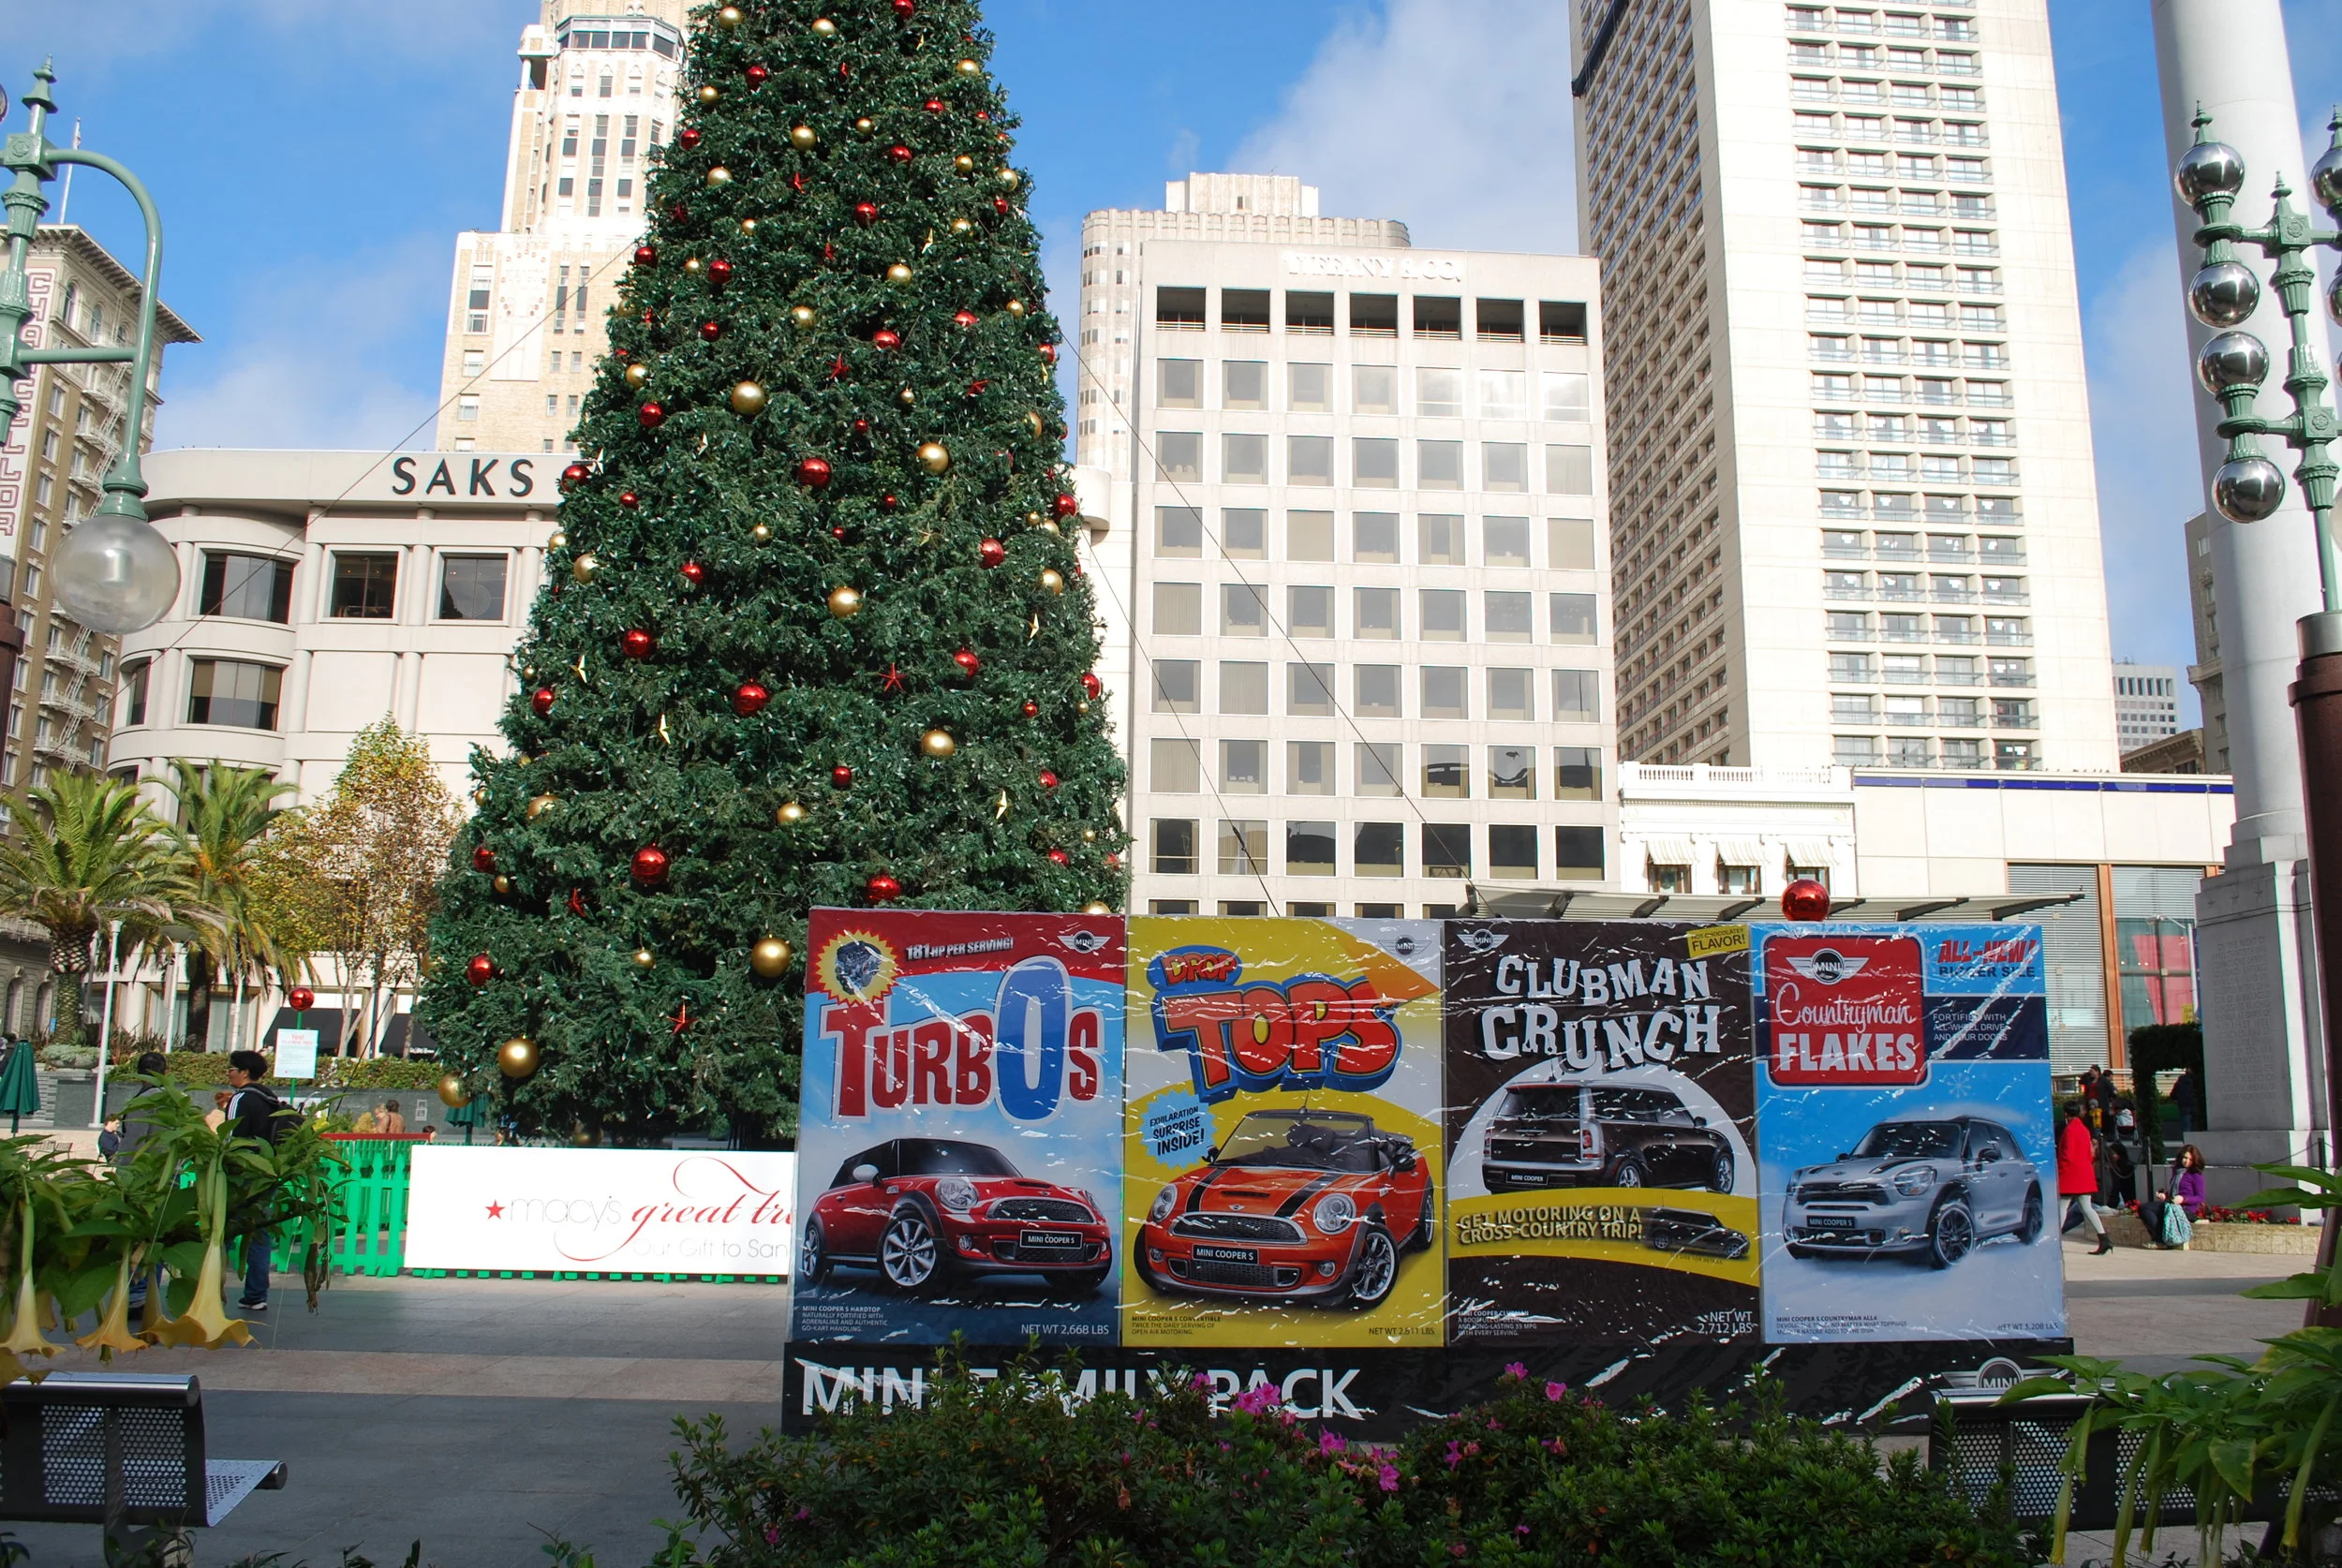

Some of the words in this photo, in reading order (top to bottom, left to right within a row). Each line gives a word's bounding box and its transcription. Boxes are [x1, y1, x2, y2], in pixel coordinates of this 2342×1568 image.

[1282, 252, 1394, 278] TIFFANY
[393, 456, 535, 497] SAKS
[906, 943, 931, 960] 181
[931, 945, 946, 957] HP
[946, 943, 966, 955] PER
[967, 937, 1014, 954] SERVING!
[1692, 934, 1746, 952] FLAVOR!
[1937, 939, 2037, 964] ALL-NEW!
[1162, 953, 1238, 985] DROP
[1814, 961, 1841, 973] MINI
[1496, 954, 1711, 1006] CLUBMAN
[1776, 982, 1917, 1033] Countryman
[1159, 978, 1401, 1092] TOPS
[1481, 1002, 1721, 1070] CRUNCH
[1778, 1033, 1917, 1072] FLAKES
[1149, 1105, 1199, 1127] EXHILARATION
[1153, 1116, 1201, 1139] SURPRISE
[1157, 1128, 1205, 1156] INSIDE!
[510, 1195, 622, 1232] macy's
[1460, 1211, 1492, 1230] GET
[1498, 1206, 1594, 1224] MOTORING
[1598, 1206, 1624, 1221] ON
[1629, 1207, 1641, 1223] A
[1809, 1218, 1823, 1226] MINI
[1460, 1220, 1599, 1244] CROSS-COUNTRY
[1600, 1221, 1643, 1240] TRIP!
[633, 1237, 672, 1256] Our
[679, 1237, 715, 1257] Gift
[722, 1238, 742, 1257] to
[748, 1238, 789, 1258] San
[1196, 1248, 1214, 1257] MINI
[1215, 1250, 1247, 1260] COOPER
[1248, 1251, 1254, 1261] S
[1710, 1311, 1731, 1322] NET
[1734, 1311, 1753, 1322] WT
[1021, 1324, 1041, 1334] NET
[1042, 1324, 1059, 1334] WT
[1060, 1324, 1089, 1335] 2,668
[1091, 1324, 1109, 1335] LBS
[1697, 1323, 1729, 1335] 2,712
[1732, 1323, 1753, 1334] LBS
[802, 1367, 942, 1415] MIN
